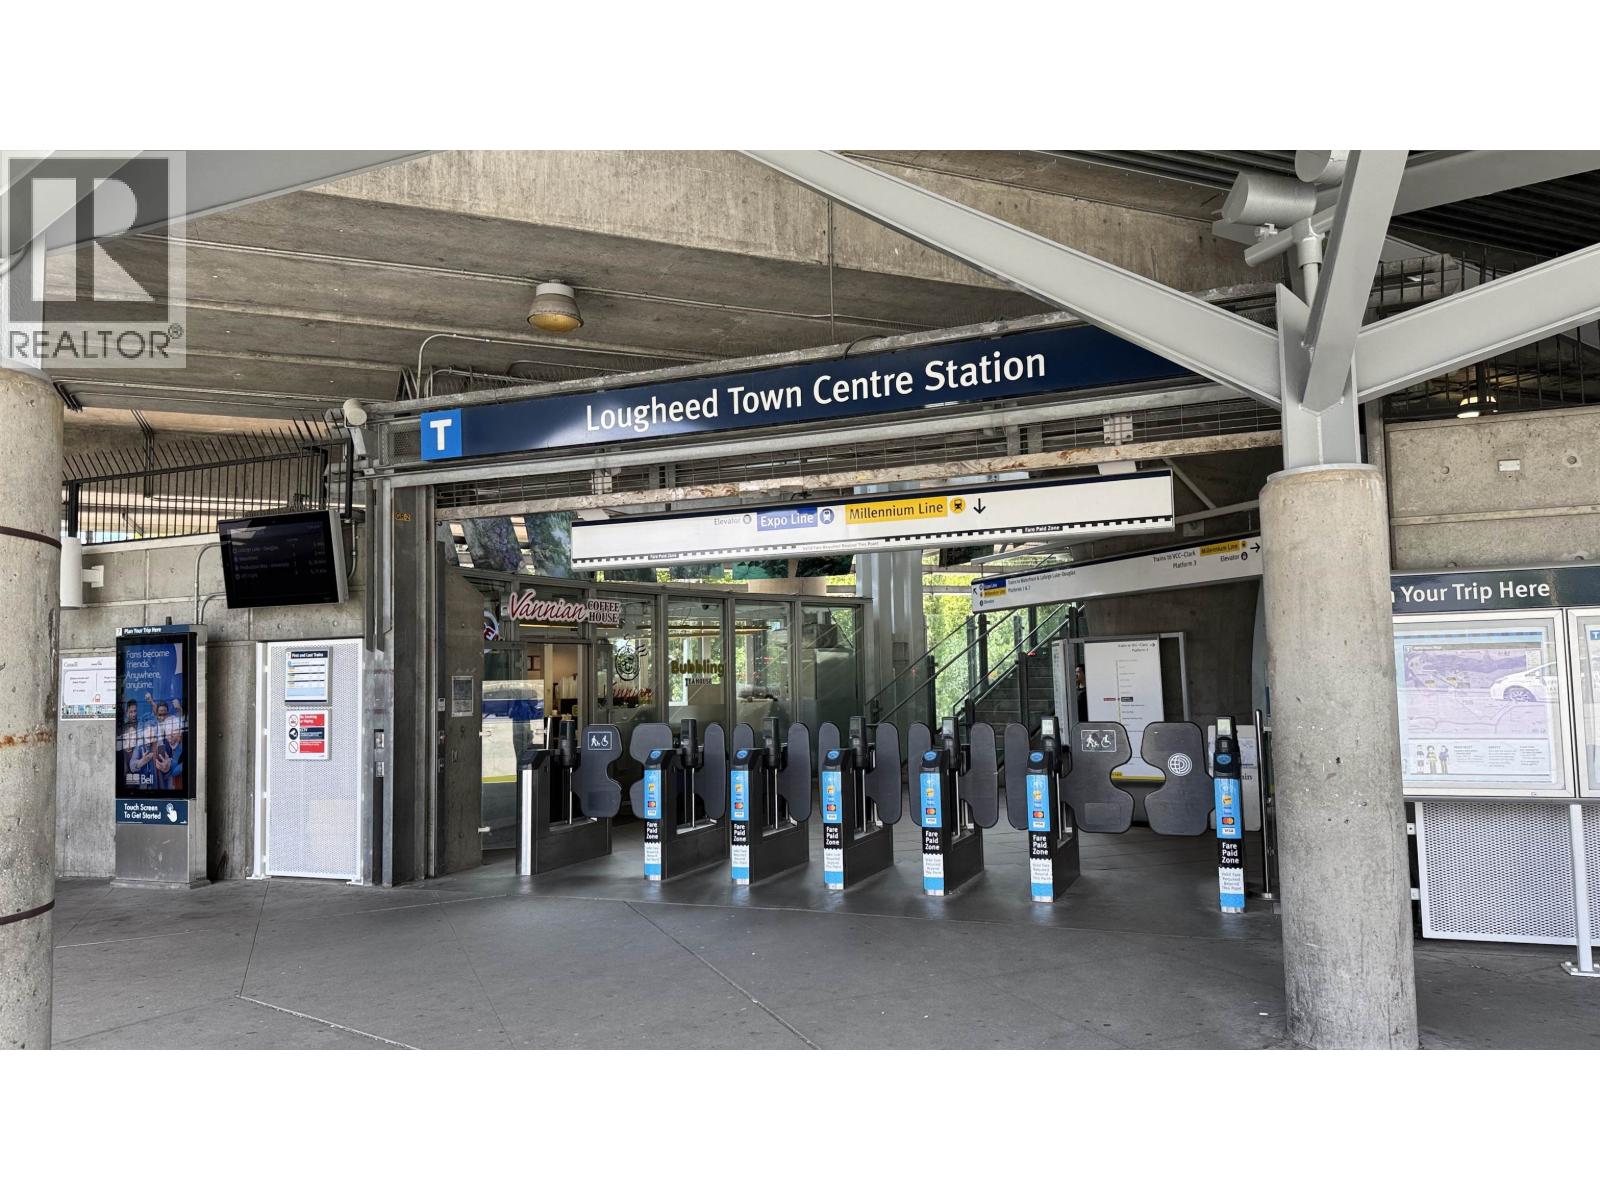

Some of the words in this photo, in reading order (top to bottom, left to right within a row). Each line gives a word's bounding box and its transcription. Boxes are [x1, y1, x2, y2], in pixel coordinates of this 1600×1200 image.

[586, 388, 719, 433] Lougheed
[727, 385, 802, 415] Town
[813, 370, 914, 405] Centre
[924, 350, 1046, 391] Station
[430, 418, 452, 451] T
[850, 504, 915, 521] Millennium
[918, 502, 944, 514] Line
[760, 515, 788, 529] Expo
[791, 513, 815, 525] Line
[1220, 554, 1240, 562] Elevator
[1173, 561, 1193, 569] Platform
[1400, 585, 1448, 603] Your
[1451, 582, 1493, 603] Trip
[1499, 581, 1551, 599] Here
[510, 591, 586, 619] Vannian
[587, 600, 620, 613] COFFEE
[588, 612, 619, 623] HOUSE
[143, 650, 170, 659] become
[671, 658, 725, 678] Bubbling
[140, 774, 154, 785] Bell
[124, 803, 140, 811] Touch
[140, 803, 158, 811] Screen
[124, 811, 131, 819] To
[131, 811, 142, 819] Get
[142, 812, 161, 820] Started
[925, 830, 939, 838] Fare
[1032, 834, 1047, 842] Fare
[1032, 841, 1048, 849] Paid
[1222, 842, 1238, 850] Fare
[1032, 848, 1049, 856] Zone
[1222, 849, 1239, 857] Paid
[1221, 856, 1240, 864] Zone
